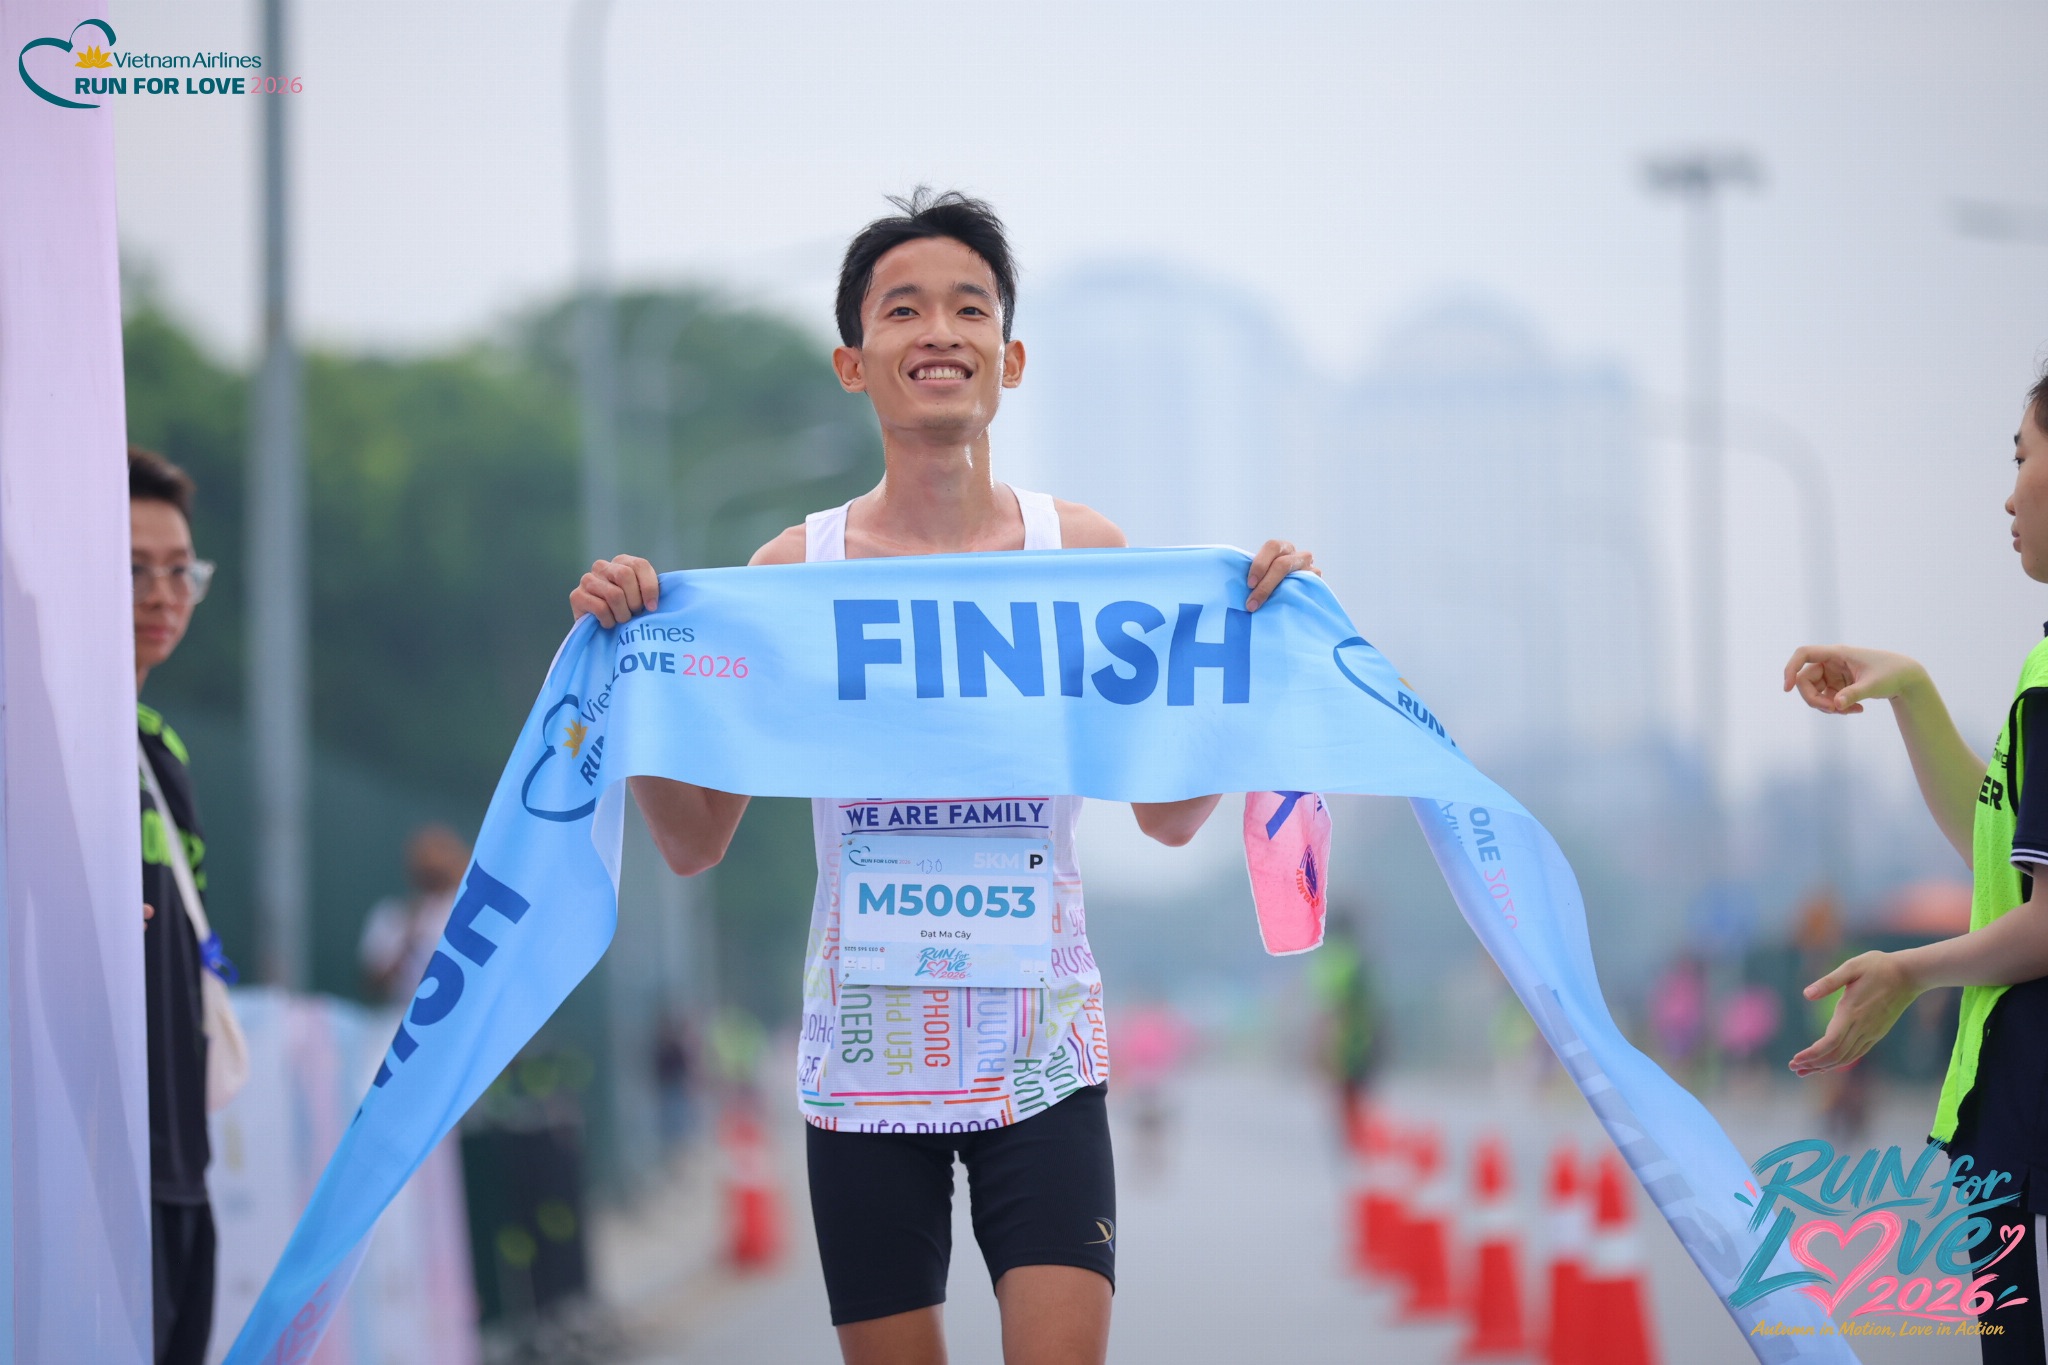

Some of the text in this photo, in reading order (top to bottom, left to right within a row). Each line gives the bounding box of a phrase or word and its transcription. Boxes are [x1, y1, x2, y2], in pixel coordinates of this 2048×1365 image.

[682, 654, 749, 679] 2026
[833, 599, 1252, 706] FINISH
[581, 683, 612, 724] Viet
[846, 802, 1044, 828] WE ARE FAMILY
[973, 852, 1044, 869] 5KM P
[858, 882, 1036, 919] M50053
